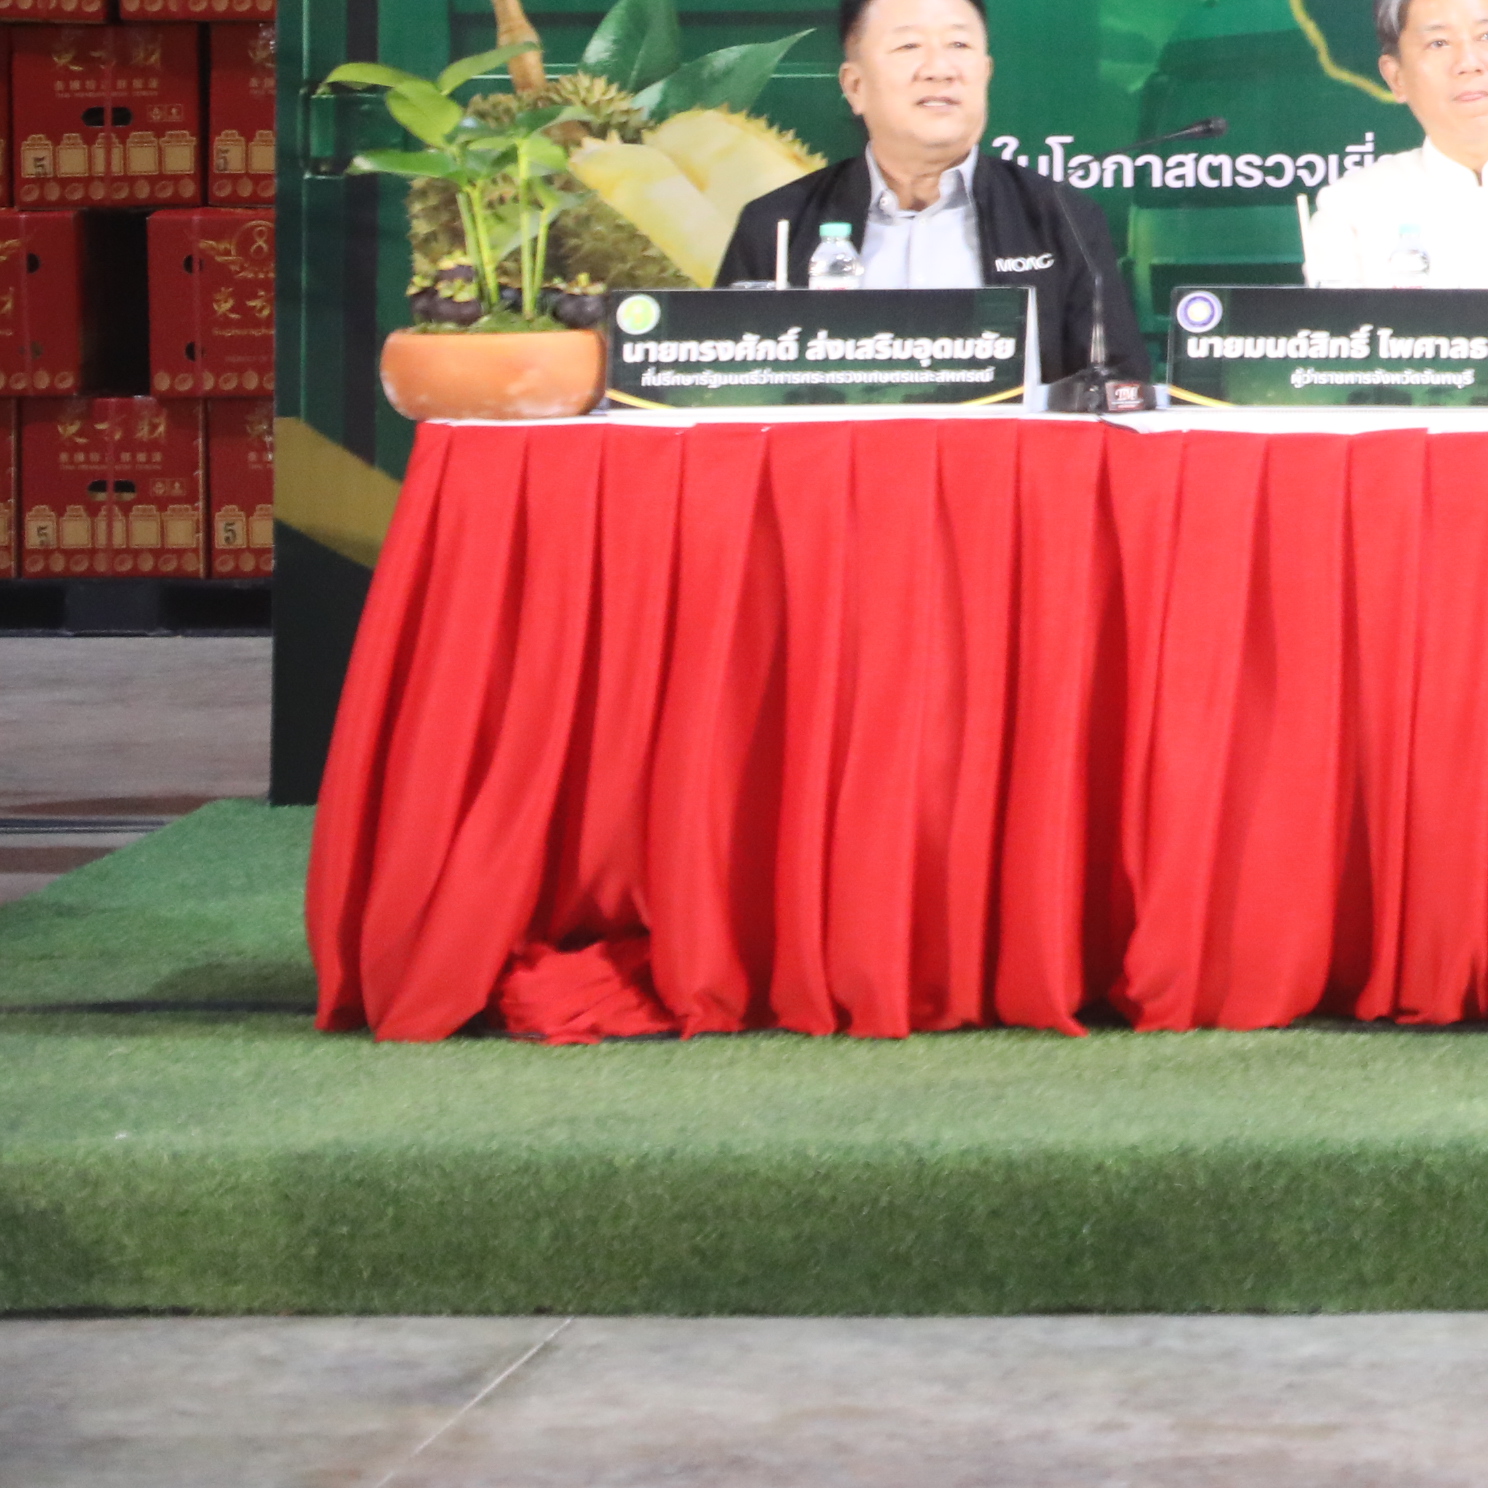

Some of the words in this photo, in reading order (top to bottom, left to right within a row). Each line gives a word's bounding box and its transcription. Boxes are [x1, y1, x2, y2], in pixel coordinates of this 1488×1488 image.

[621, 327, 802, 362] นายทรงศักดิ์
[804, 330, 1017, 368] ส่งเสริมอุดมชัย
[1185, 323, 1374, 360] นายมนต์สิทธิ์
[222, 520, 238, 546] 5
